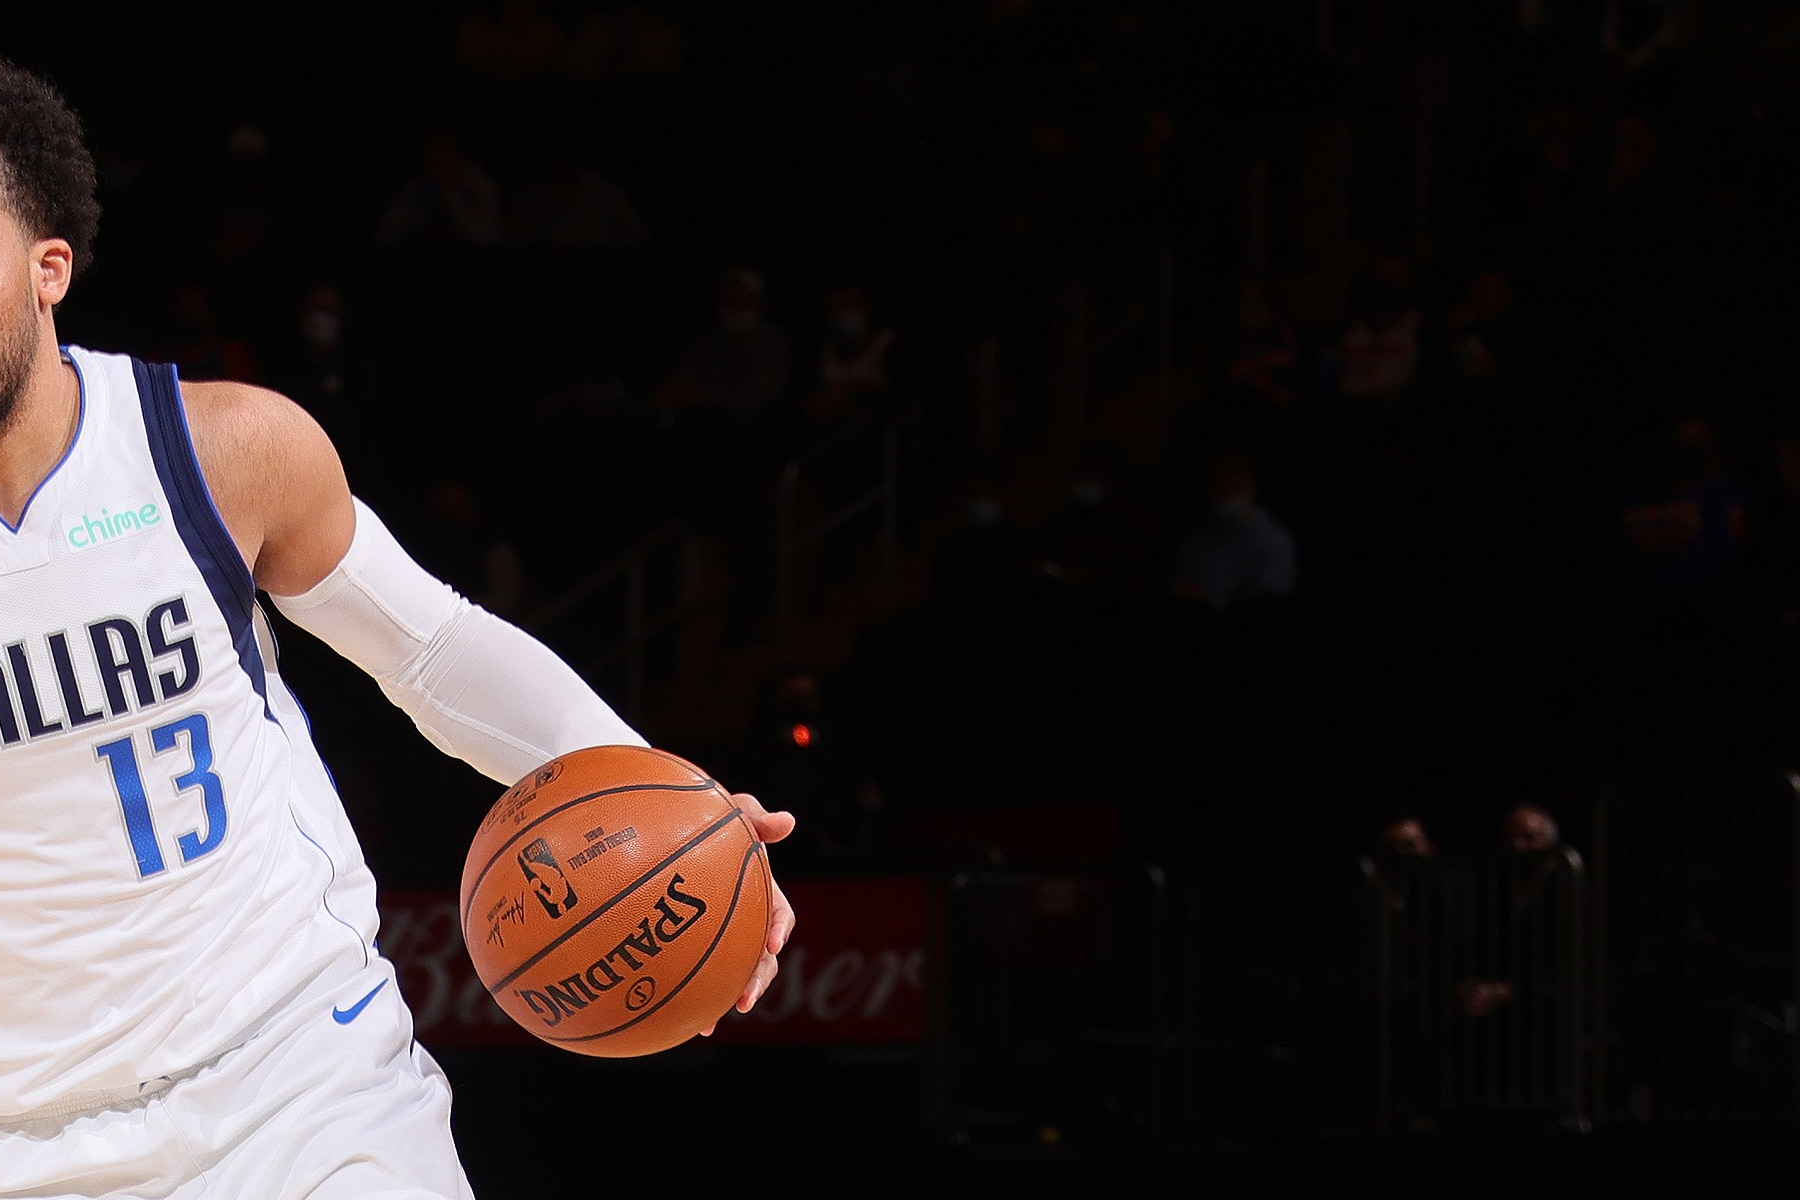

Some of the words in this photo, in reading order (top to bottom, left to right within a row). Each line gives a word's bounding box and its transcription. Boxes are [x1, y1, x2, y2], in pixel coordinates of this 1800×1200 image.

[69, 503, 161, 548] chime
[91, 710, 230, 882] 13
[566, 851, 588, 870] BALL
[583, 840, 606, 861] GAME
[516, 872, 707, 1027] SPALDING
